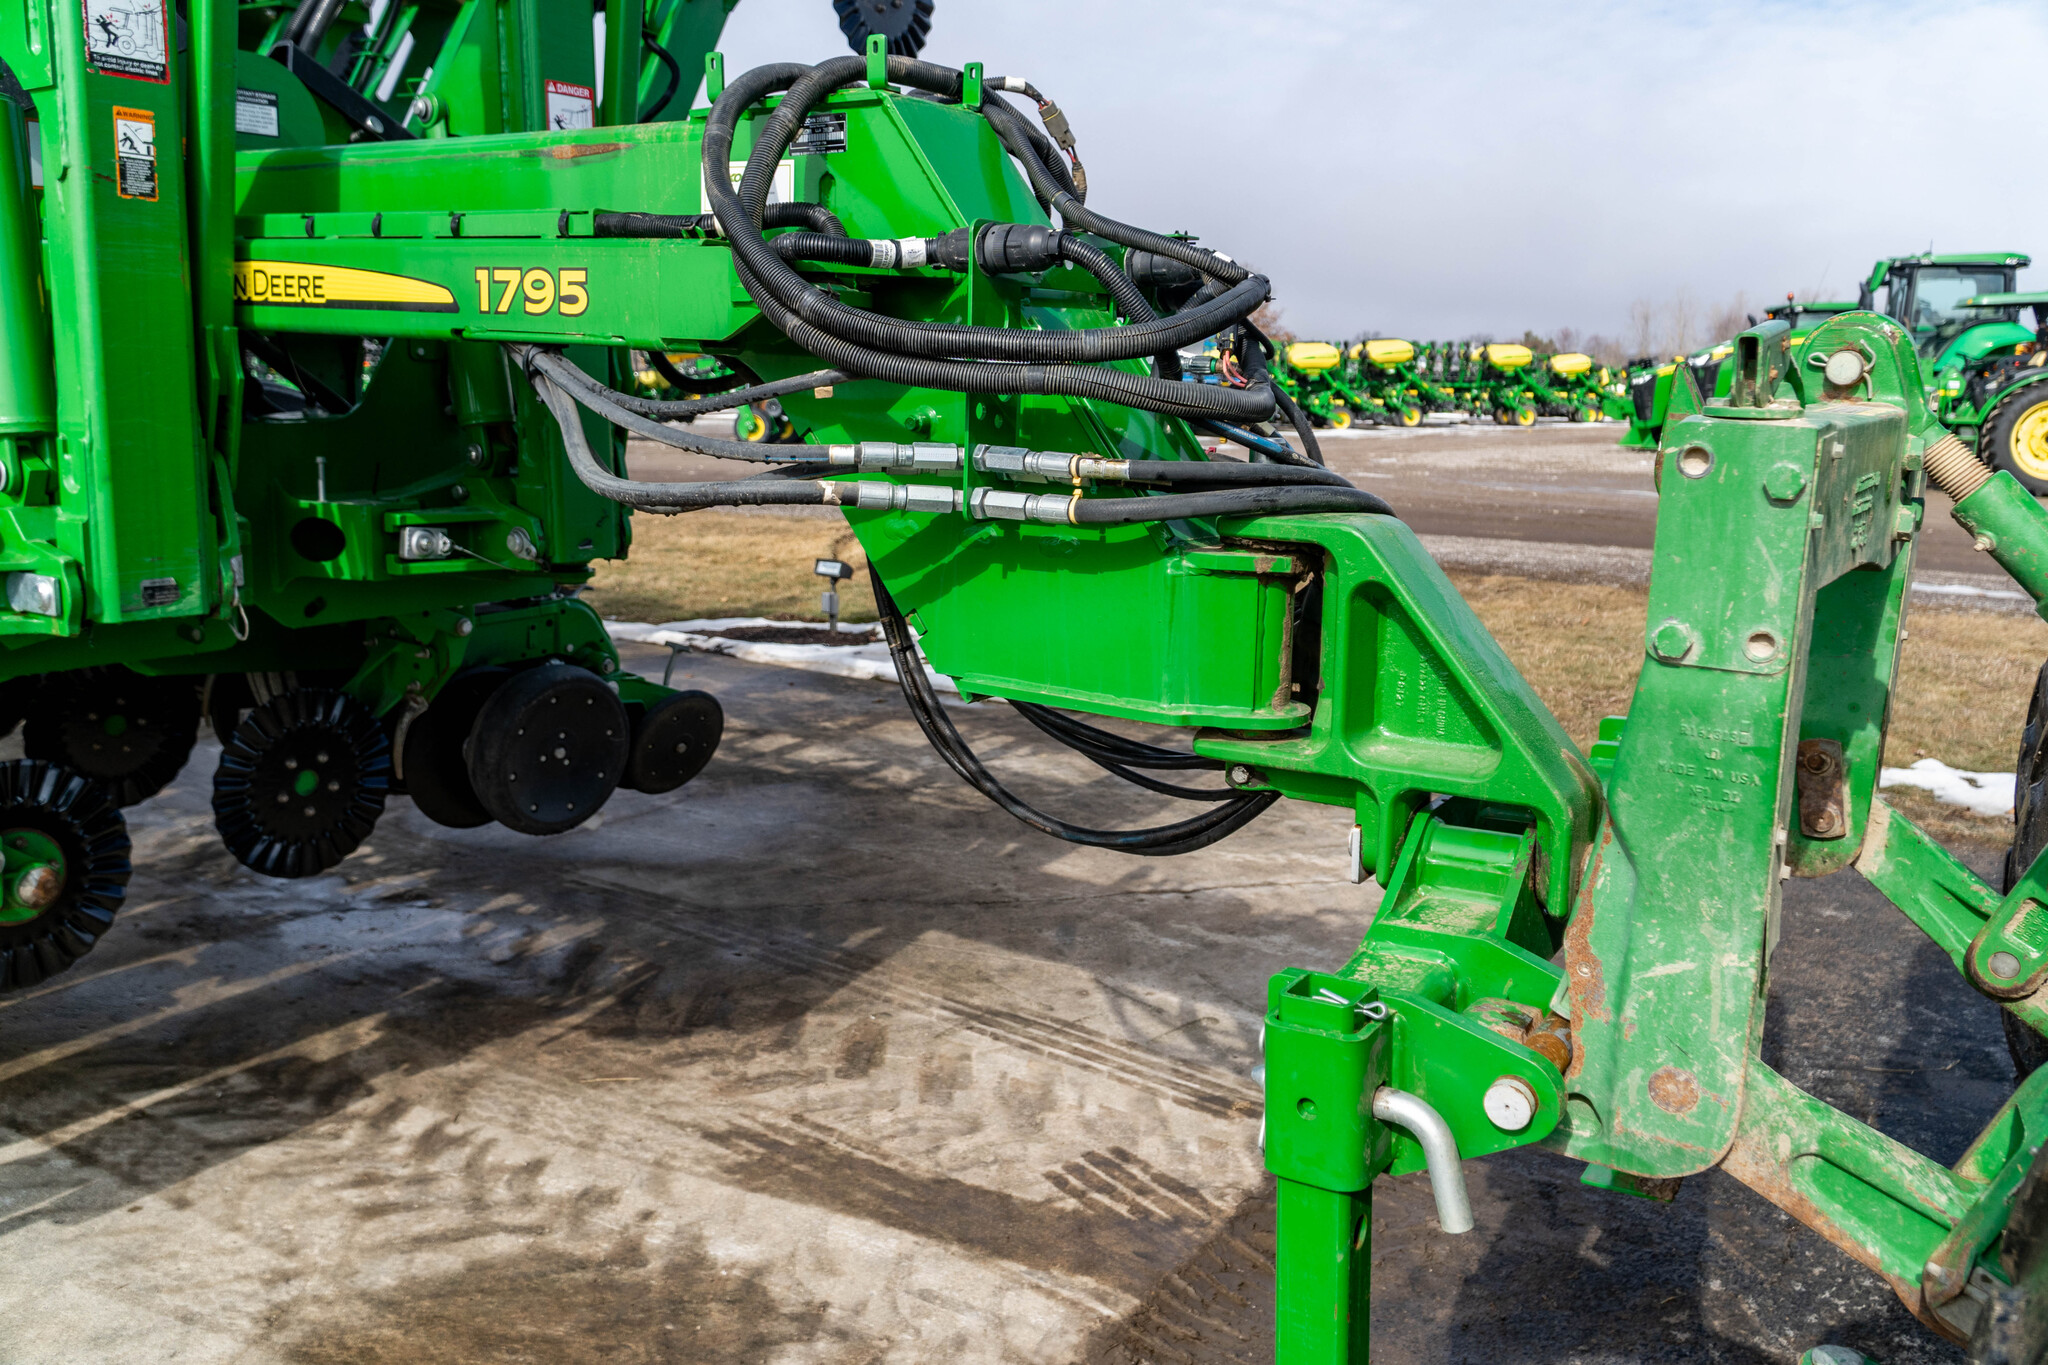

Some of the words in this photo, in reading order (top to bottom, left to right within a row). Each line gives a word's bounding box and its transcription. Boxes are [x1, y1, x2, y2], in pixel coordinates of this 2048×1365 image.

[556, 83, 590, 98] DANGER
[122, 111, 154, 120] WARNING
[253, 269, 326, 298] DEERE
[475, 266, 589, 317] 1795
[1658, 759, 1697, 777] MADE
[1704, 766, 1725, 781] IN
[1730, 771, 1762, 787] USA
